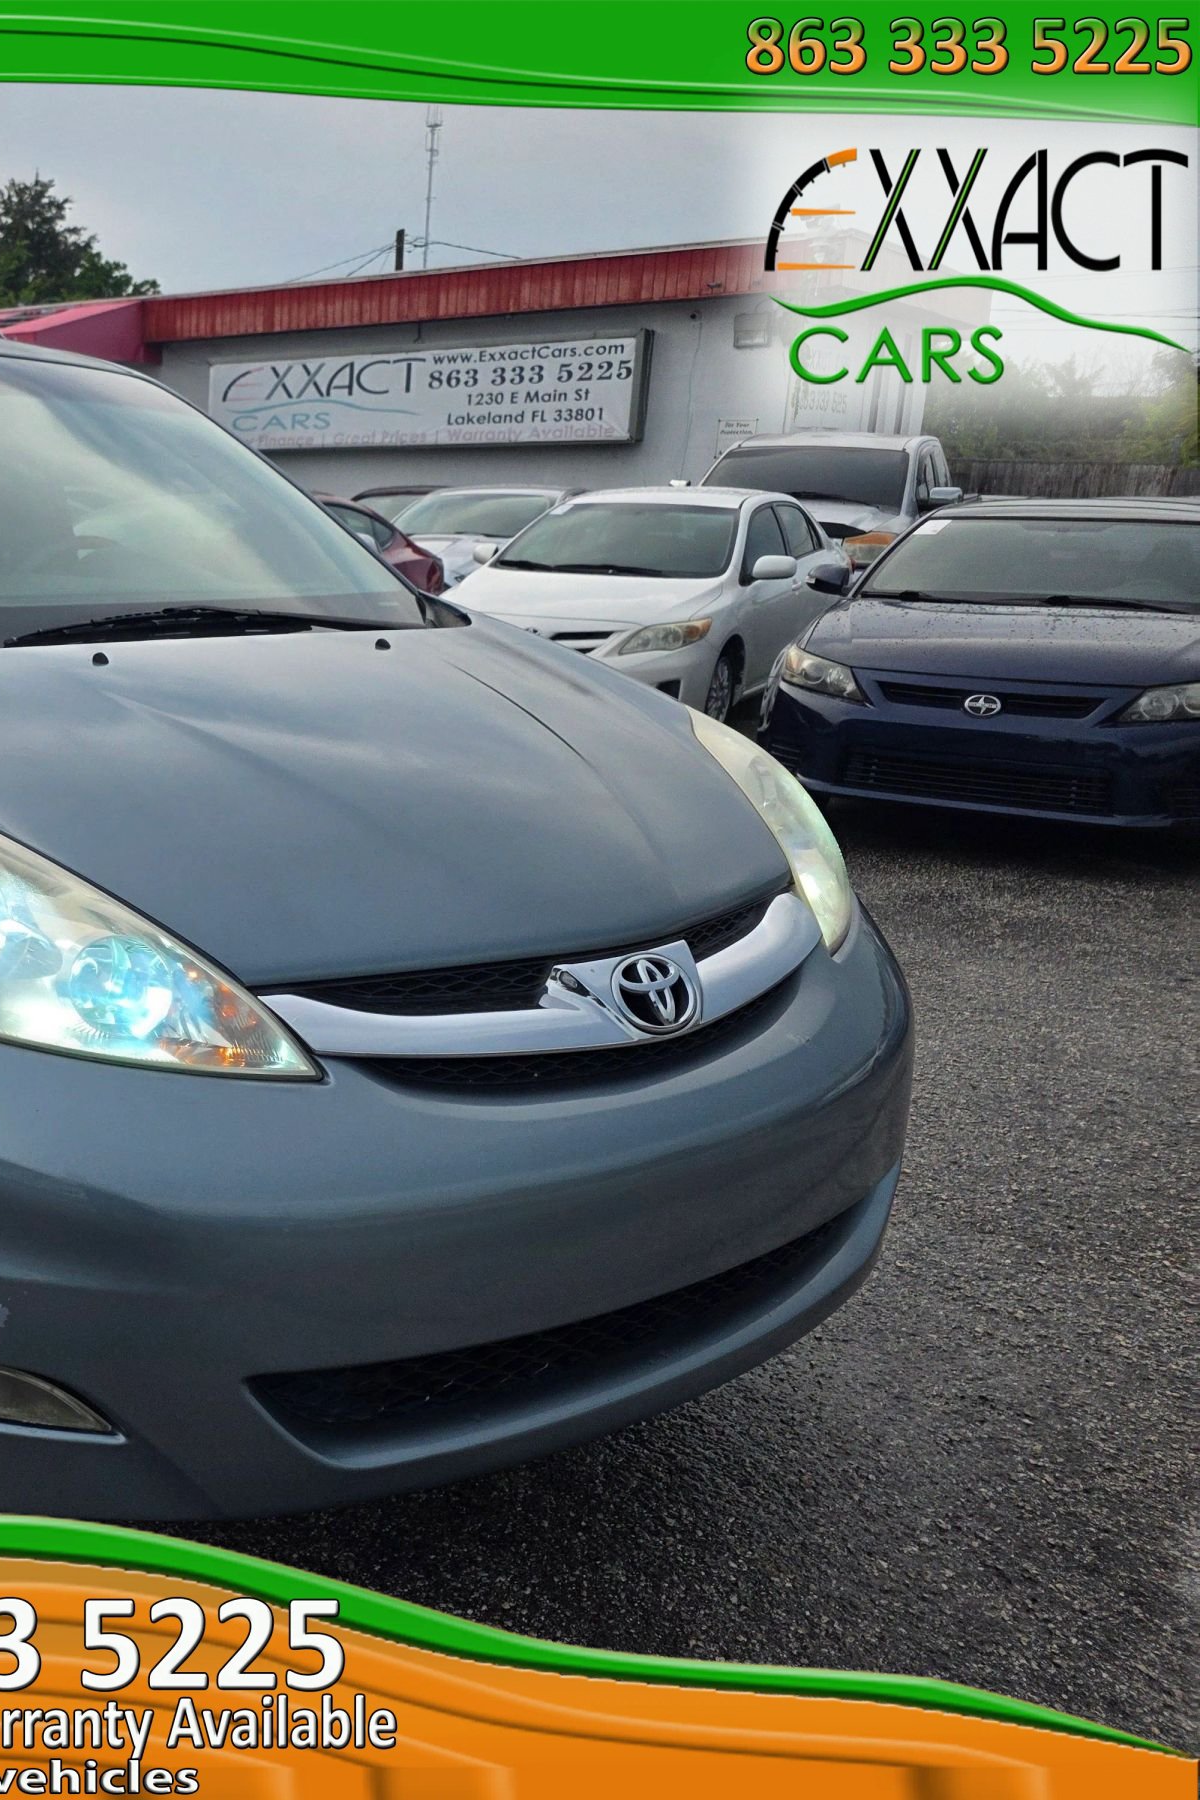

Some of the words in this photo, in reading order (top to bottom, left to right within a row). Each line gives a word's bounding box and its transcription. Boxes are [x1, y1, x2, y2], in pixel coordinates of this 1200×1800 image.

[433, 344, 625, 365] www.ExxactCars.com
[222, 358, 427, 402] EXXACT
[428, 368, 479, 389] 863
[490, 365, 545, 387] 333
[556, 360, 633, 383] 5225
[466, 392, 504, 406] 1230
[510, 392, 519, 404] E
[524, 390, 568, 404] Main
[574, 388, 590, 402] St
[232, 412, 331, 431] CARS
[447, 410, 525, 426] Lakeland
[531, 409, 546, 424] FL
[553, 408, 604, 422] 33801
[447, 427, 522, 443] Warranty
[530, 424, 616, 440] Available
